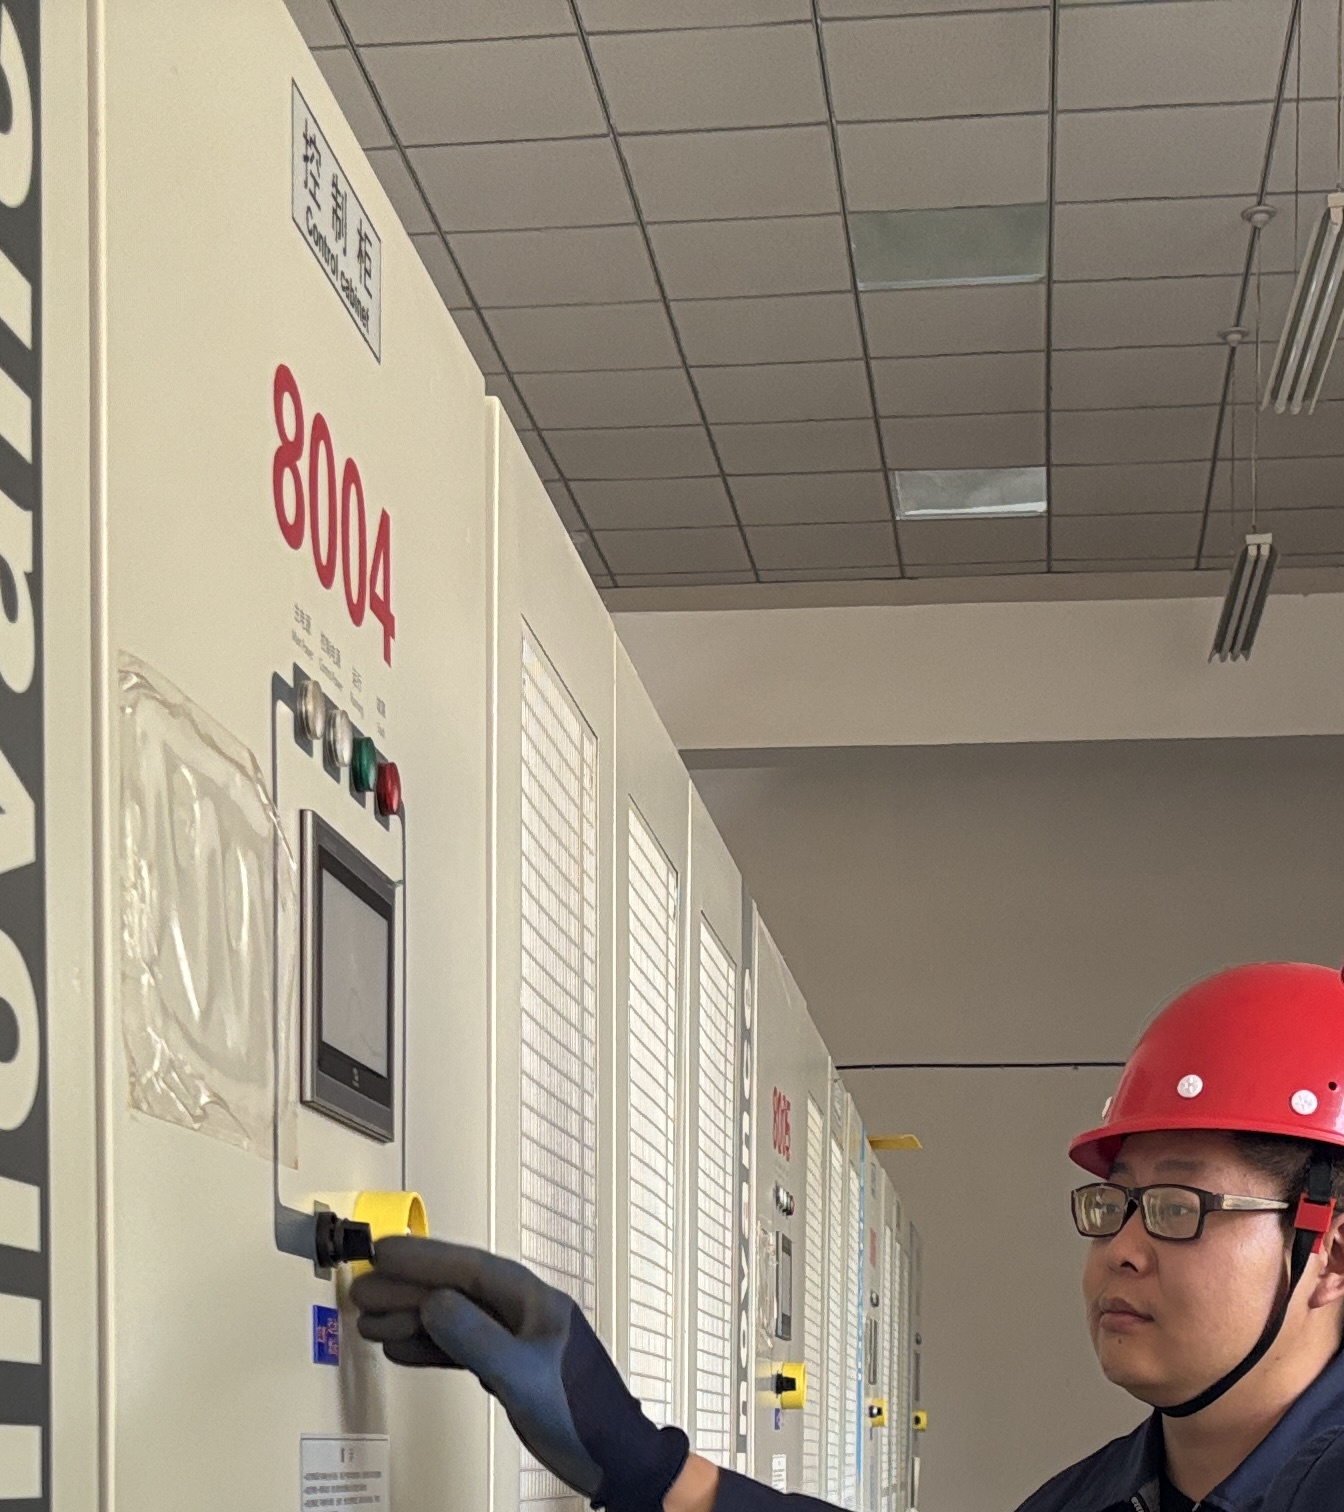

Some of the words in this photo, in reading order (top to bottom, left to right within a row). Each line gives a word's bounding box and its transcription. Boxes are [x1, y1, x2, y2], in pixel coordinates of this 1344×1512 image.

[302, 117, 373, 300] 控制柜
[306, 205, 339, 281] Control
[340, 269, 370, 333] cabinet
[272, 363, 396, 667] 8004
